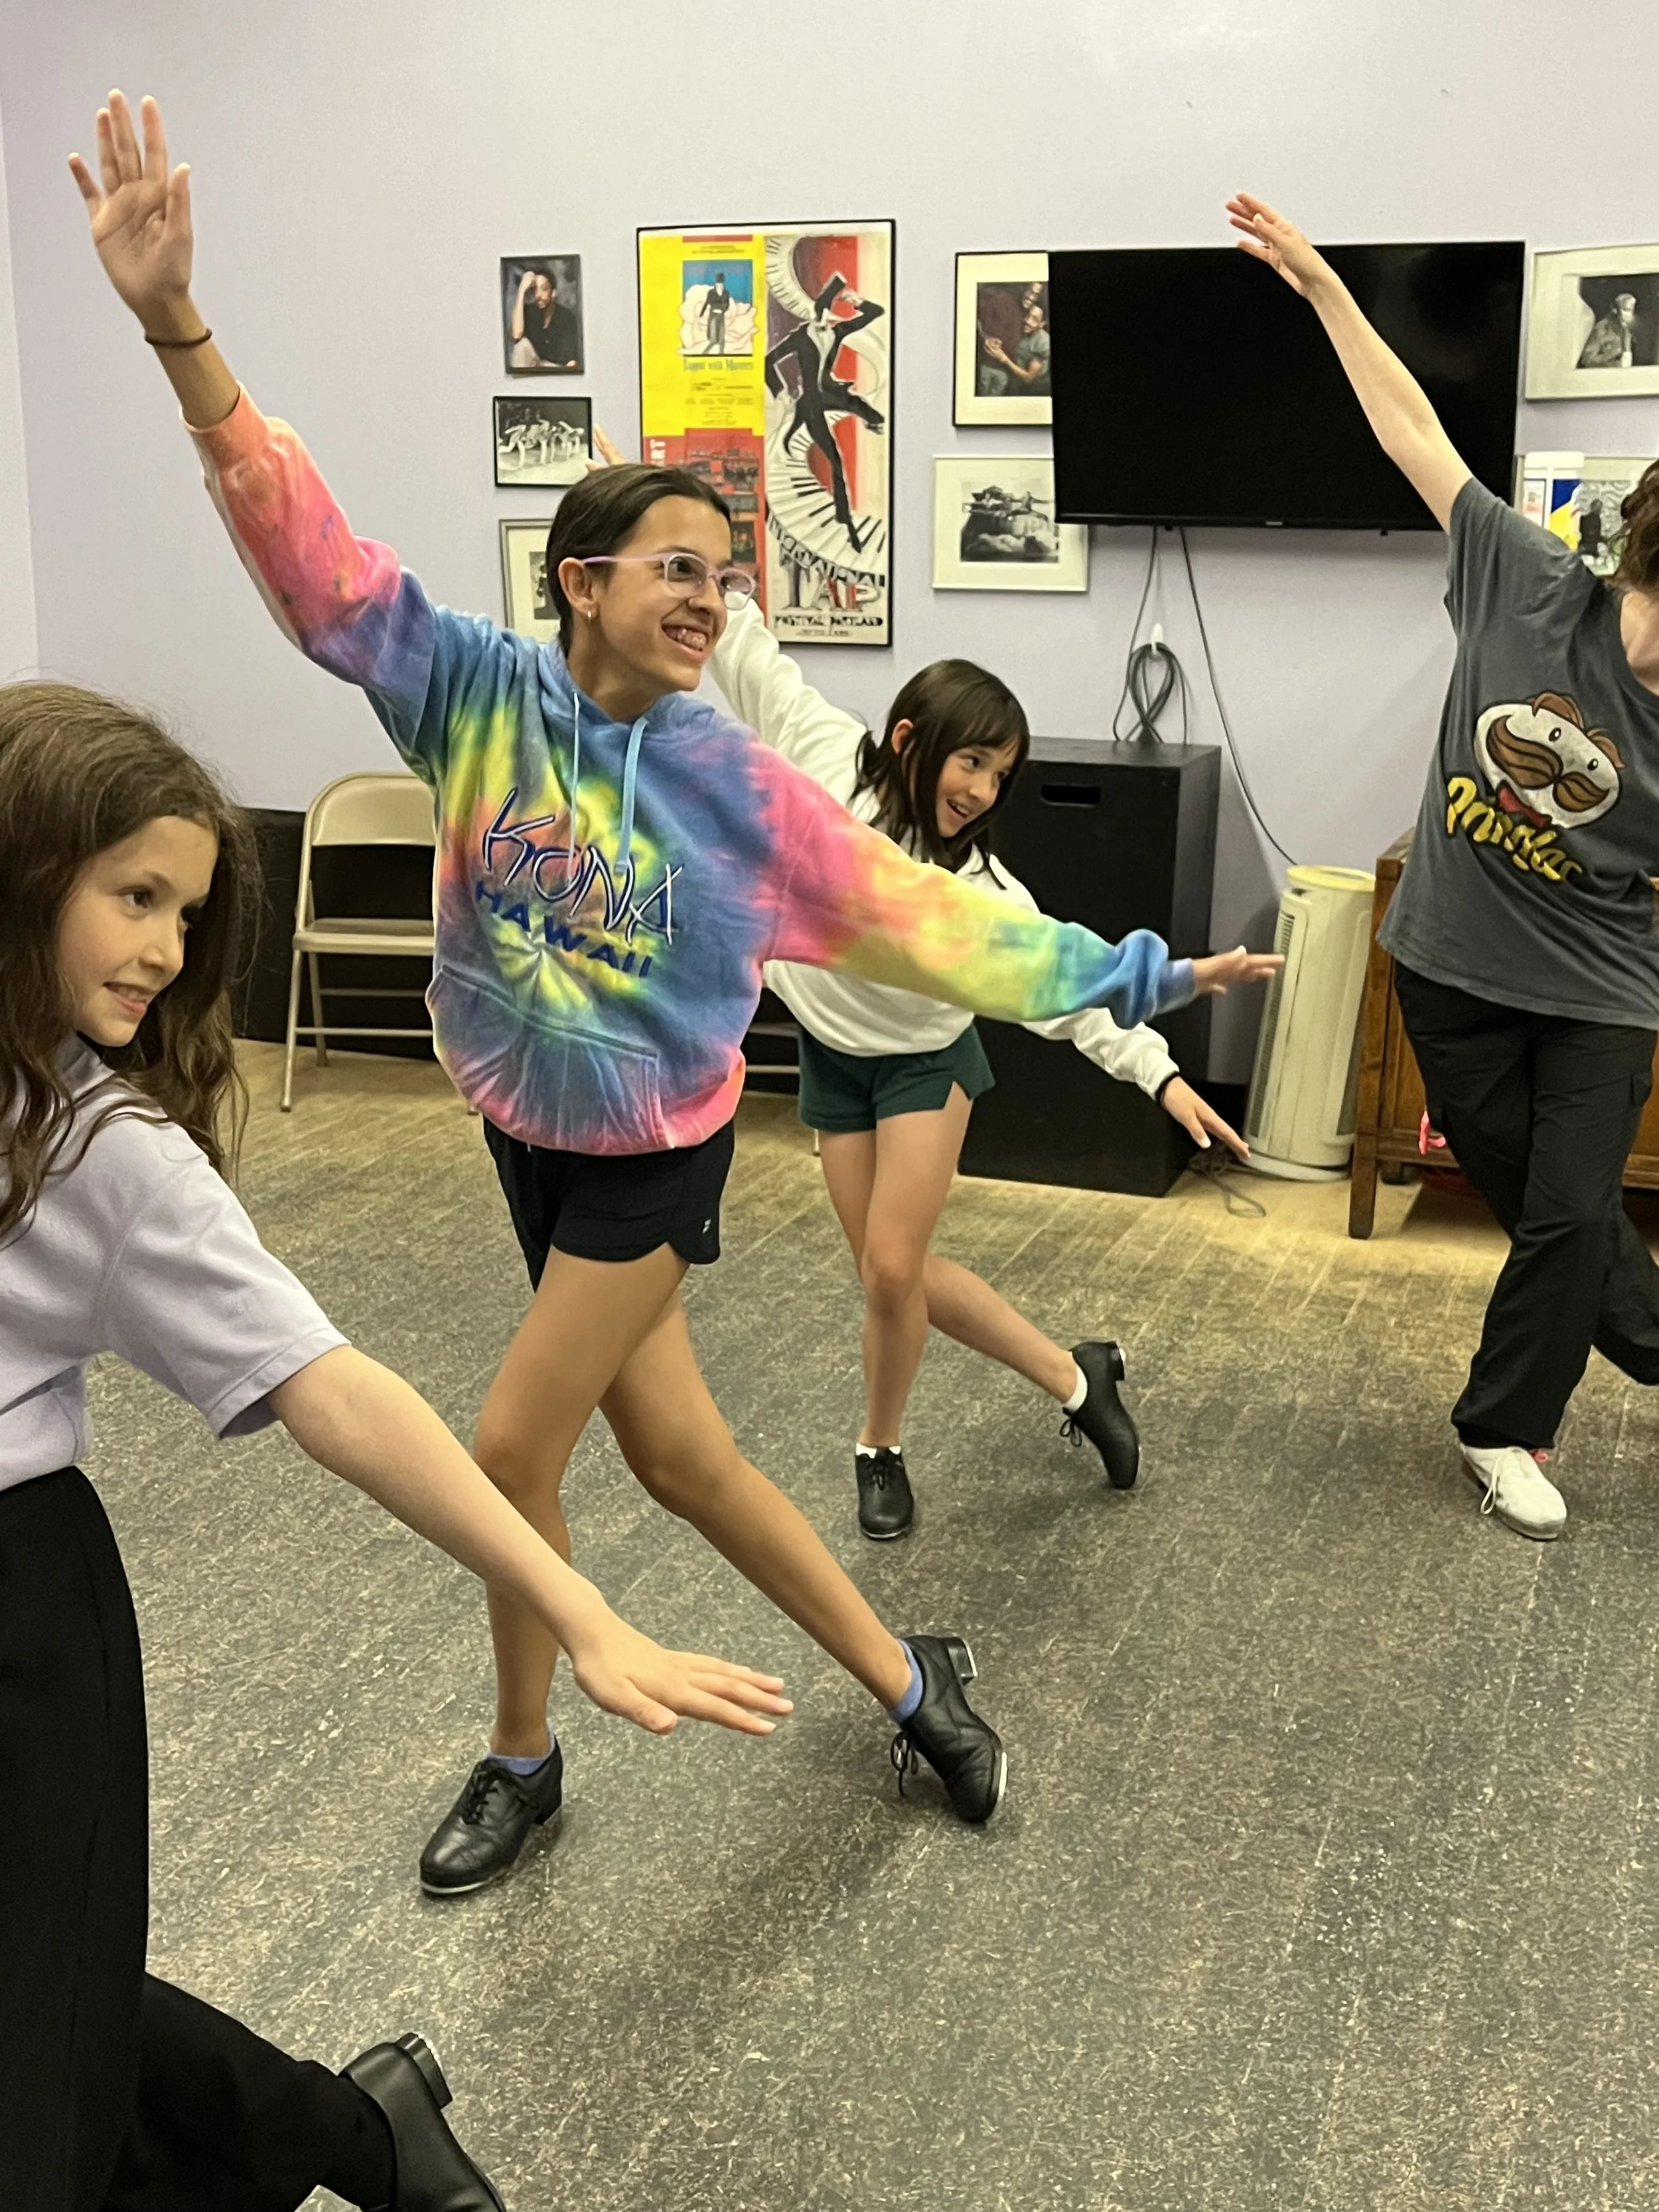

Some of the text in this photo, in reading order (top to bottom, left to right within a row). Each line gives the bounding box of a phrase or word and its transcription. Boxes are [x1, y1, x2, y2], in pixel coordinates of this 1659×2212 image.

[779, 548, 881, 613] TAP
[774, 615, 883, 632] FESTIVAL PORTLAND
[482, 787, 684, 946] KONA
[475, 881, 652, 978] HAWAII
